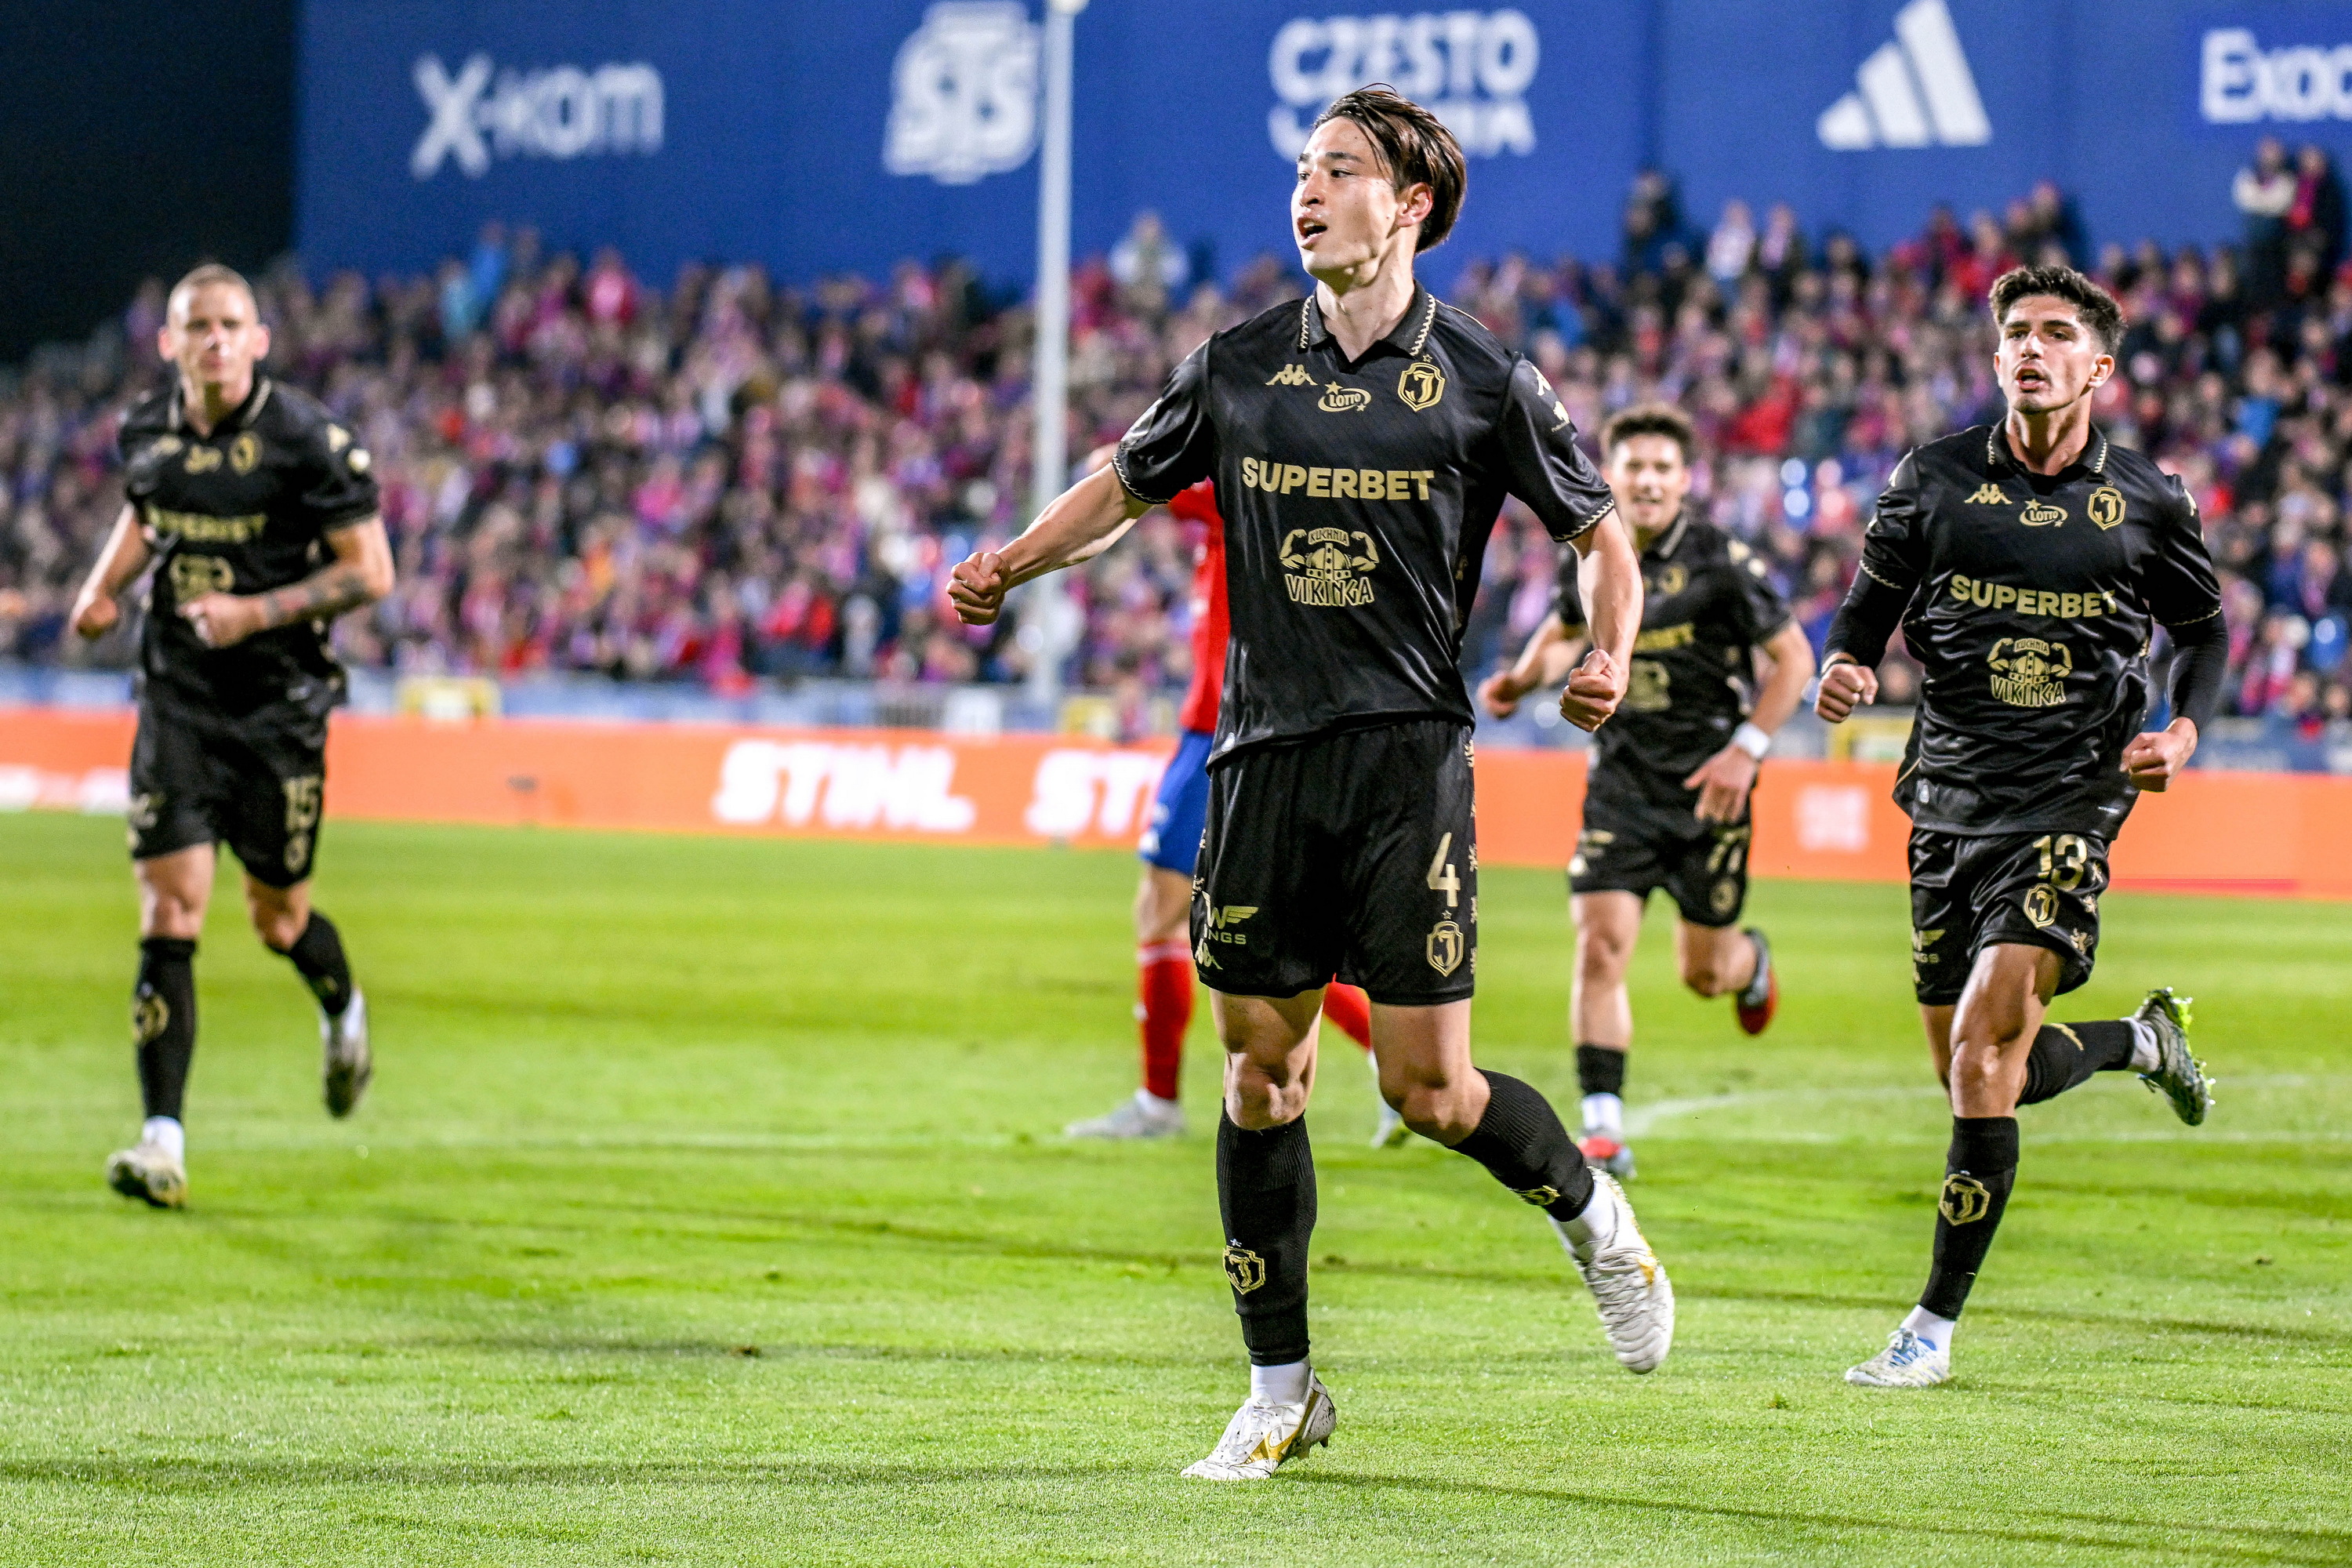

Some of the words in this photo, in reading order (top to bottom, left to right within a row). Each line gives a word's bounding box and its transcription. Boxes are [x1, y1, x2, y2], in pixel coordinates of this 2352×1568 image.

[1329, 393, 1361, 407] LOTTO
[1242, 456, 1435, 500] SUPERBET
[1285, 574, 1374, 607] VIKINGA
[1950, 574, 2117, 619] SUPERBET
[1991, 674, 2067, 707] VIKINGA
[715, 739, 975, 831] STIHL
[1427, 832, 1461, 907] 4
[2033, 833, 2087, 892] 13
